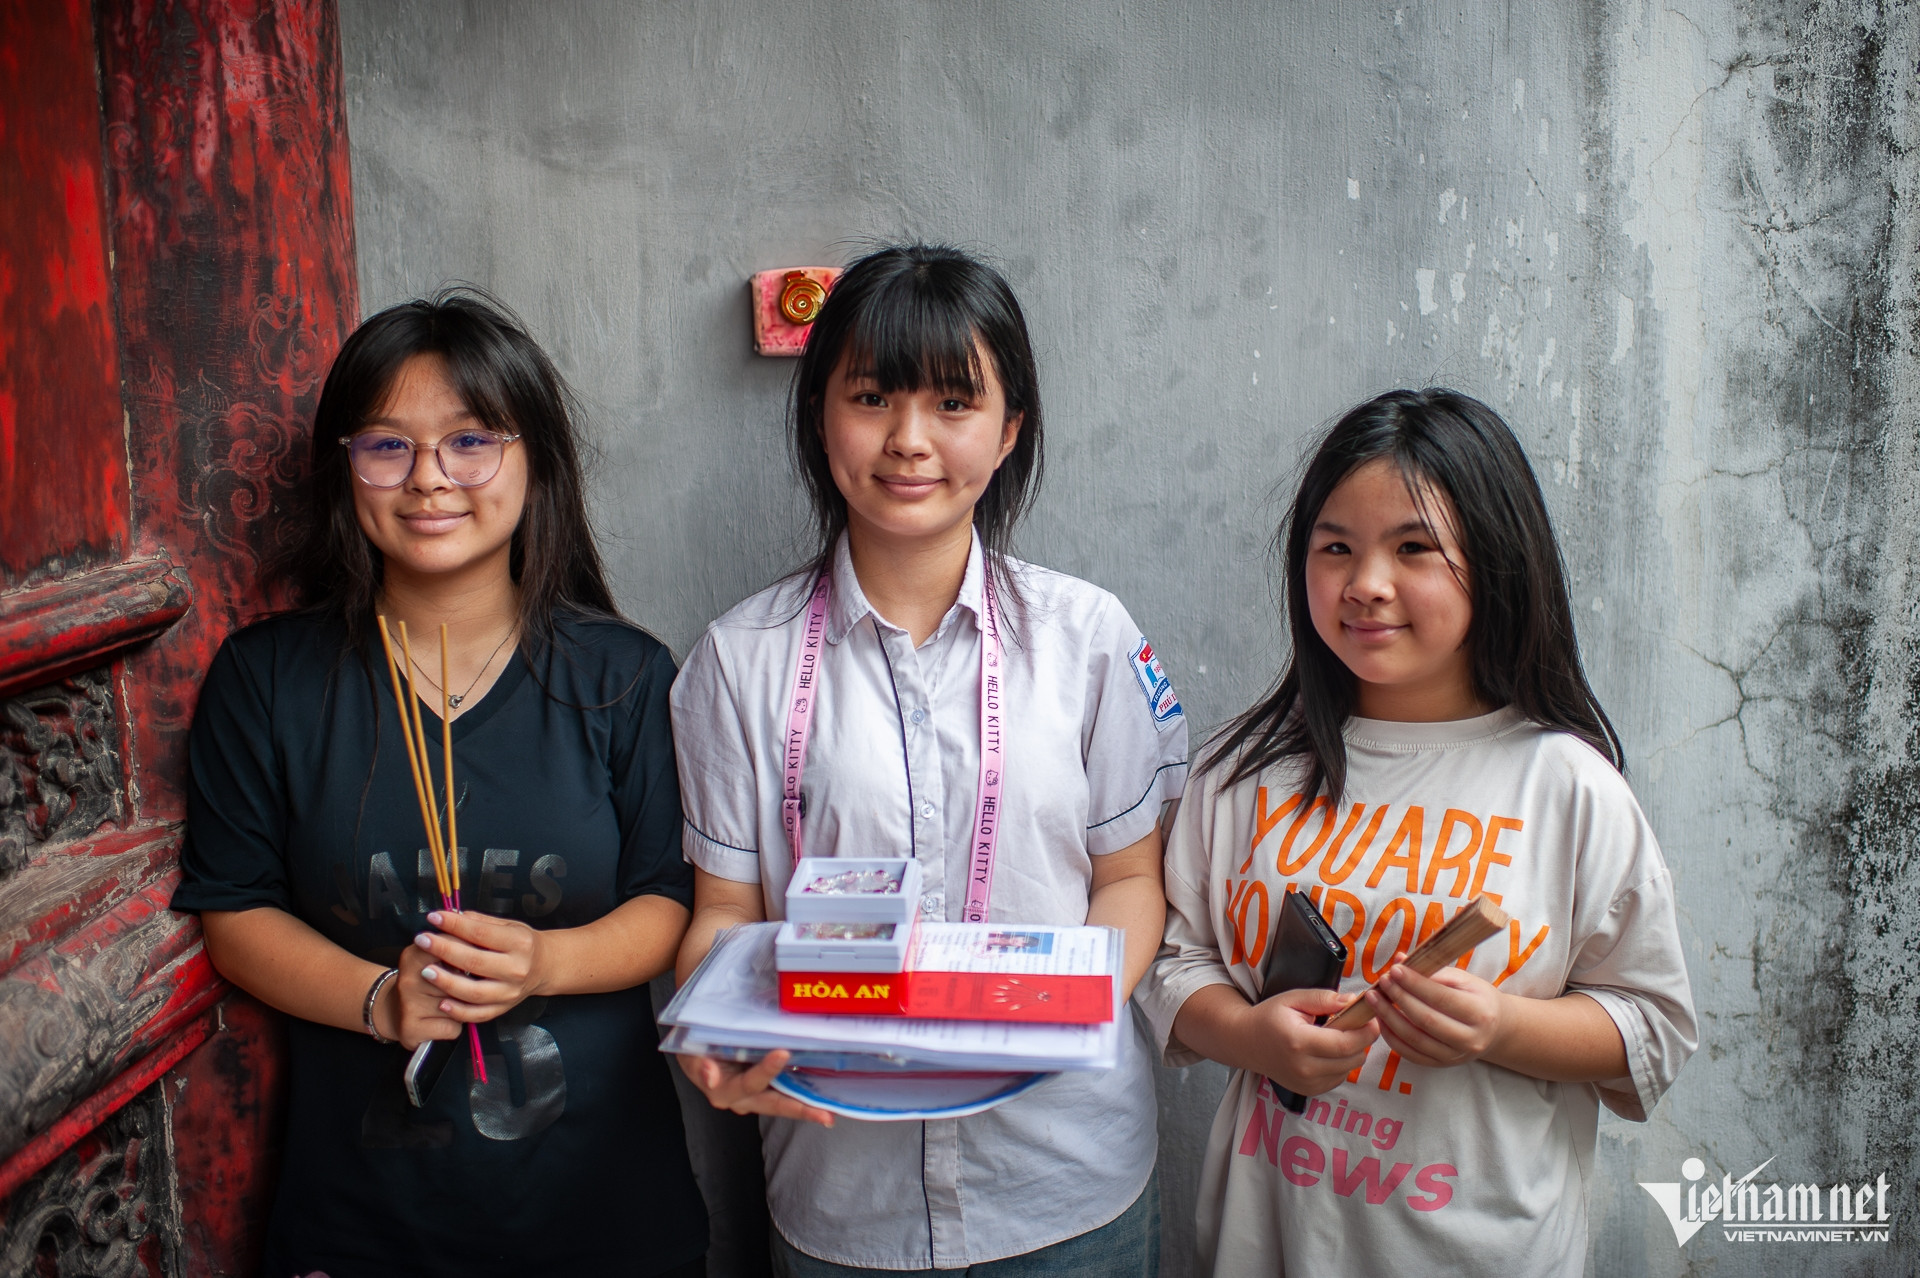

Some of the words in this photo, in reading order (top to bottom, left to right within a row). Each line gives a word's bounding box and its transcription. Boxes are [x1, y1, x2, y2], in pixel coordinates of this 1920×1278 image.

[806, 612, 823, 648] KITTY
[798, 654, 816, 689] HELLO
[987, 675, 999, 710] HELLO
[788, 729, 802, 769] KITTY
[987, 715, 1000, 754] KITTY
[981, 796, 996, 835] HELLO
[975, 842, 991, 884] KITTY
[1240, 786, 1390, 886] YOU
[1365, 806, 1524, 908] ARE
[331, 847, 567, 926] JAMES
[1226, 879, 1366, 979] YOR
[1361, 897, 1551, 988] OY
[792, 980, 849, 998] HÒA
[854, 984, 890, 999] AN
[1257, 1075, 1404, 1150] Ening
[1239, 1098, 1459, 1212] News
